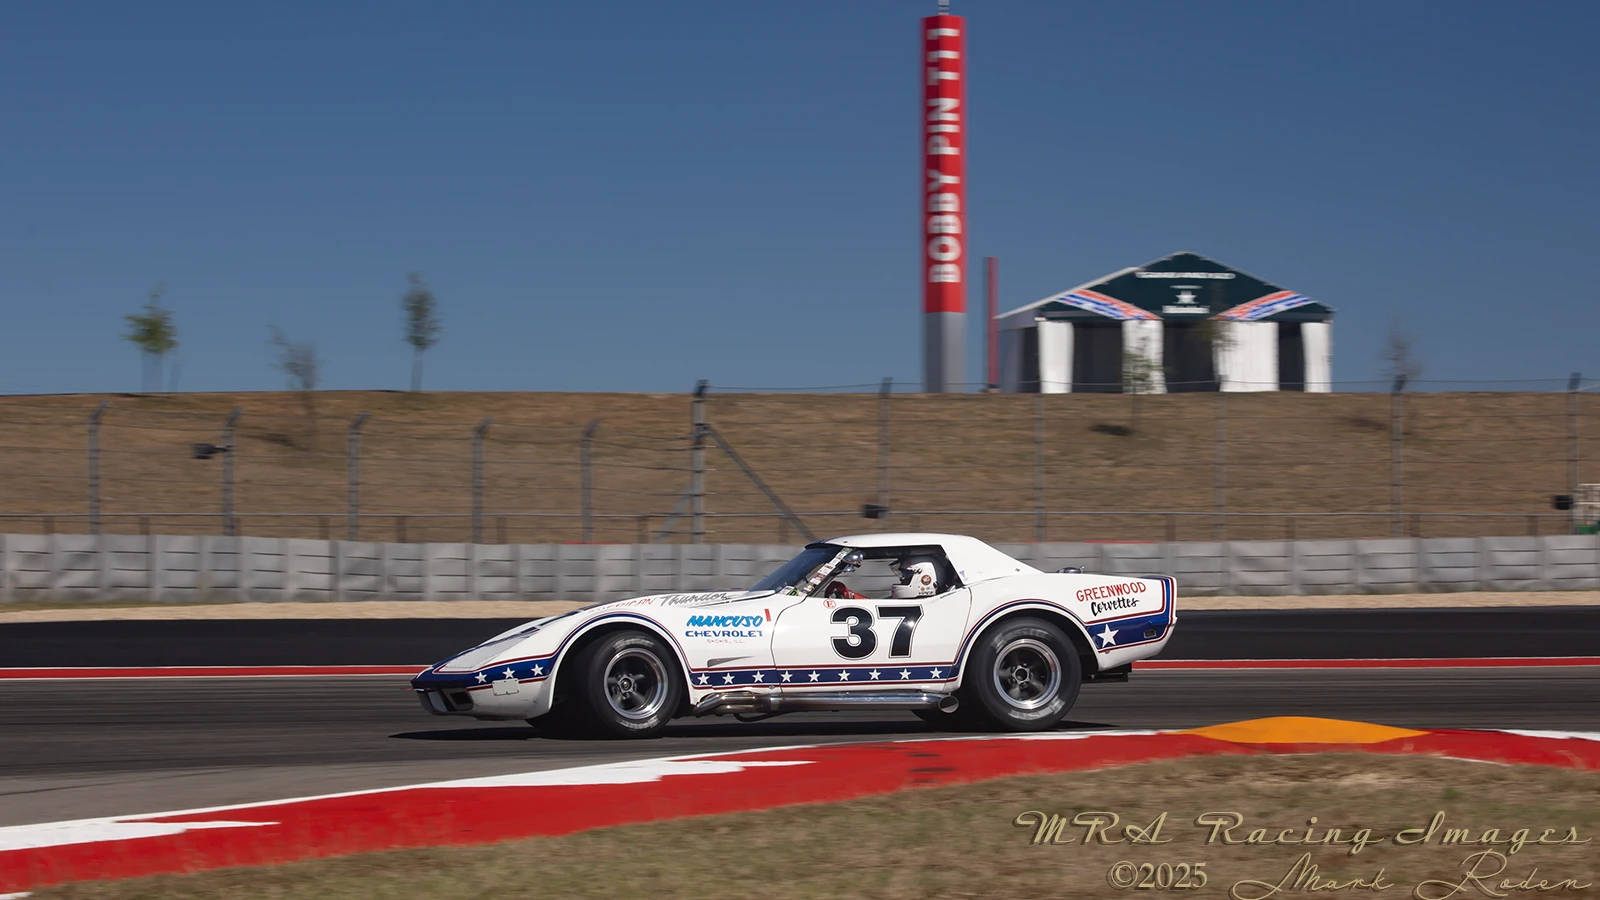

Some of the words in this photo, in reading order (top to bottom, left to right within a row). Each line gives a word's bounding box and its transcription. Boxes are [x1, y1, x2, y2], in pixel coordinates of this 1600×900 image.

[926, 27, 960, 86] T11
[927, 97, 961, 155] PIN
[927, 168, 962, 284] BOBBY
[1076, 581, 1147, 602] GREENWOOD
[1090, 596, 1140, 617] Corvettes
[685, 630, 763, 638] CHEVROLET
[686, 615, 763, 628] MANCUSO
[829, 604, 924, 661] 37
